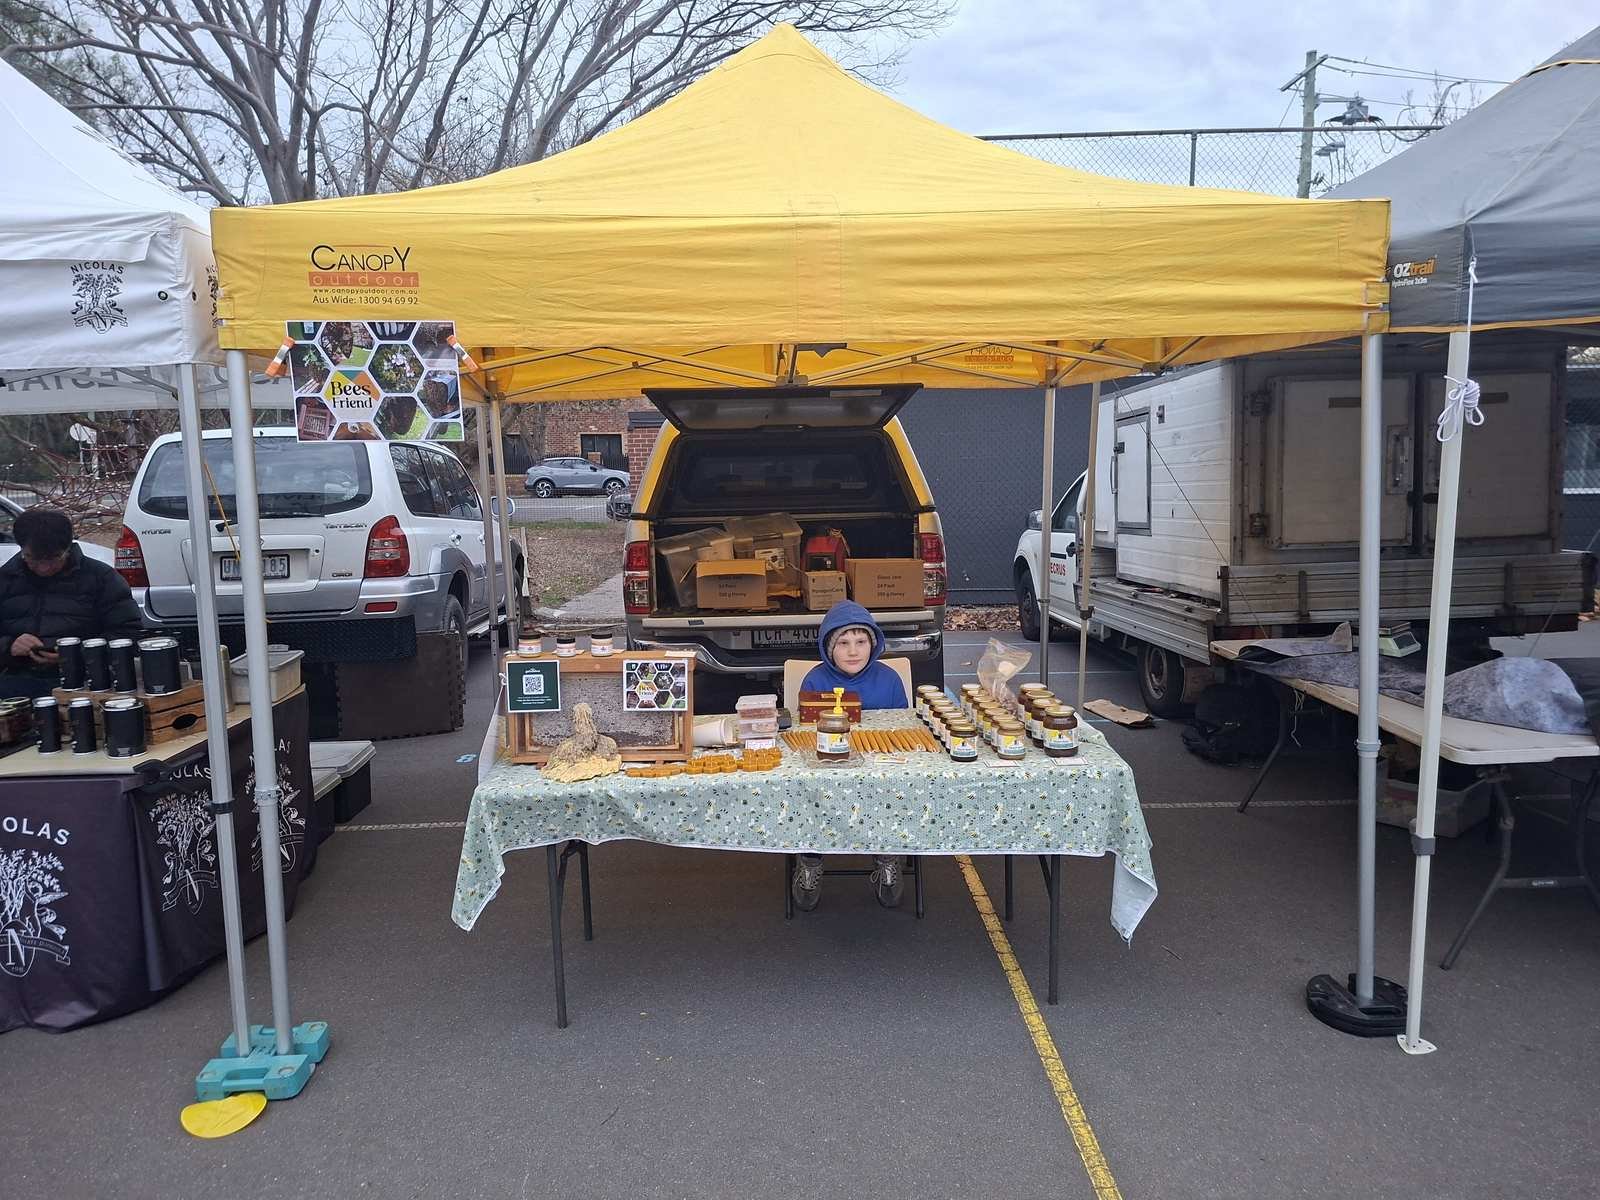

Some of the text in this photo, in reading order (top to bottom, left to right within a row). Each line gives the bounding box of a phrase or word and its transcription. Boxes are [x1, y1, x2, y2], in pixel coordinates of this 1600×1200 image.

[311, 245, 411, 271] CANOPY
[70, 261, 125, 275] NICOLAS
[312, 273, 416, 286] outdoor
[312, 295, 419, 305] Aus Wide: 1300 94 69 92
[330, 381, 372, 396] Bees
[332, 397, 373, 409] Friend
[2, 816, 71, 846] OLAS
